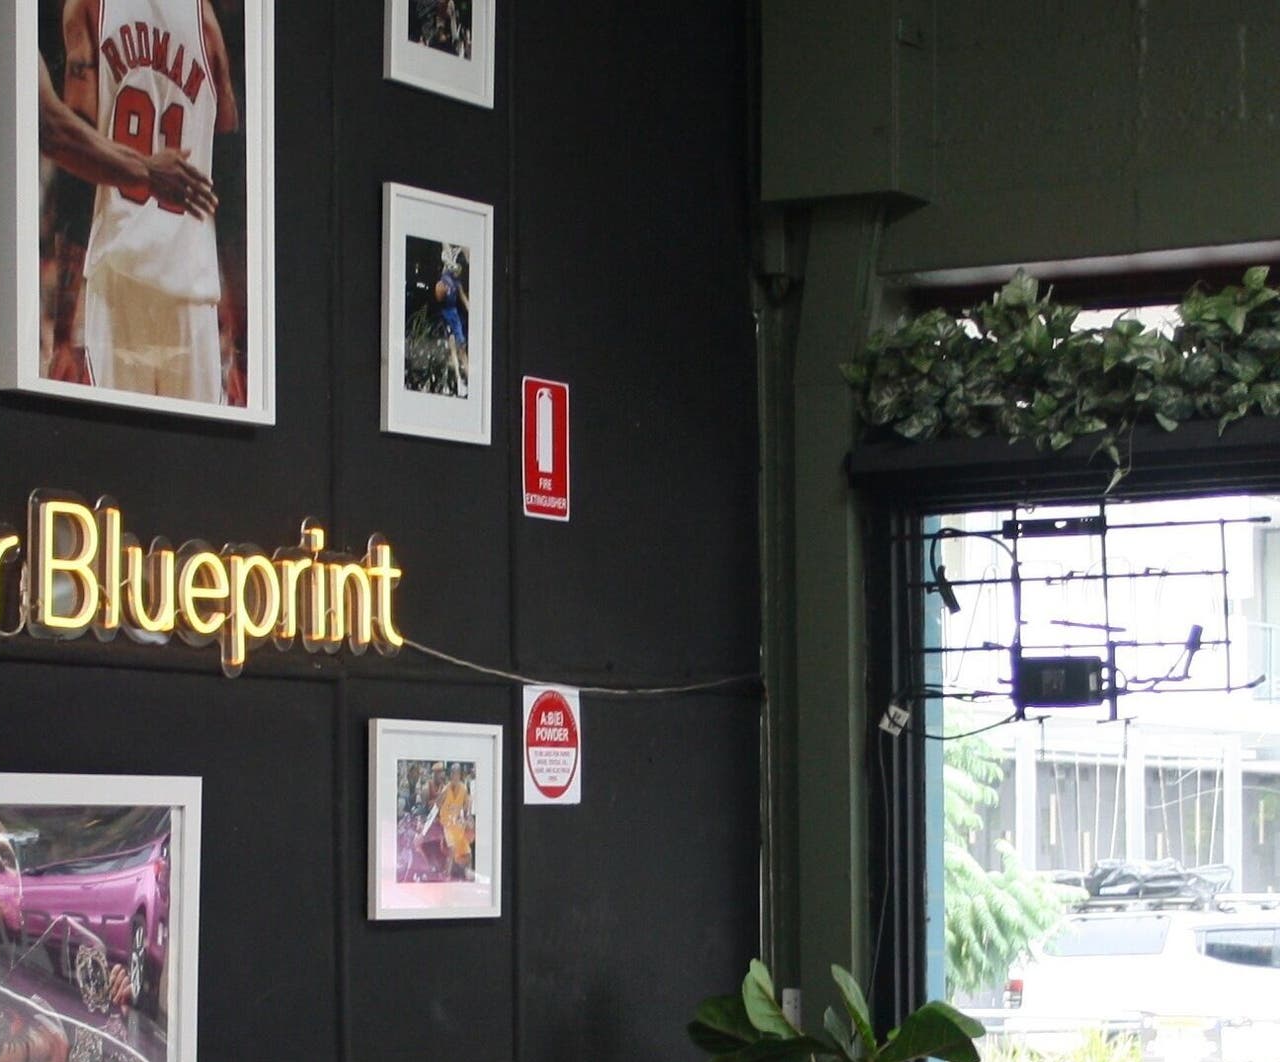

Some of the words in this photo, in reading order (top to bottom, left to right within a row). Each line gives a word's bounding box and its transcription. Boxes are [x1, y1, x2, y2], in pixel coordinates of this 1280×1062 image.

[101, 21, 206, 105] RODMAN
[41, 501, 403, 664] Blueprint
[535, 727, 569, 742] POWDER
